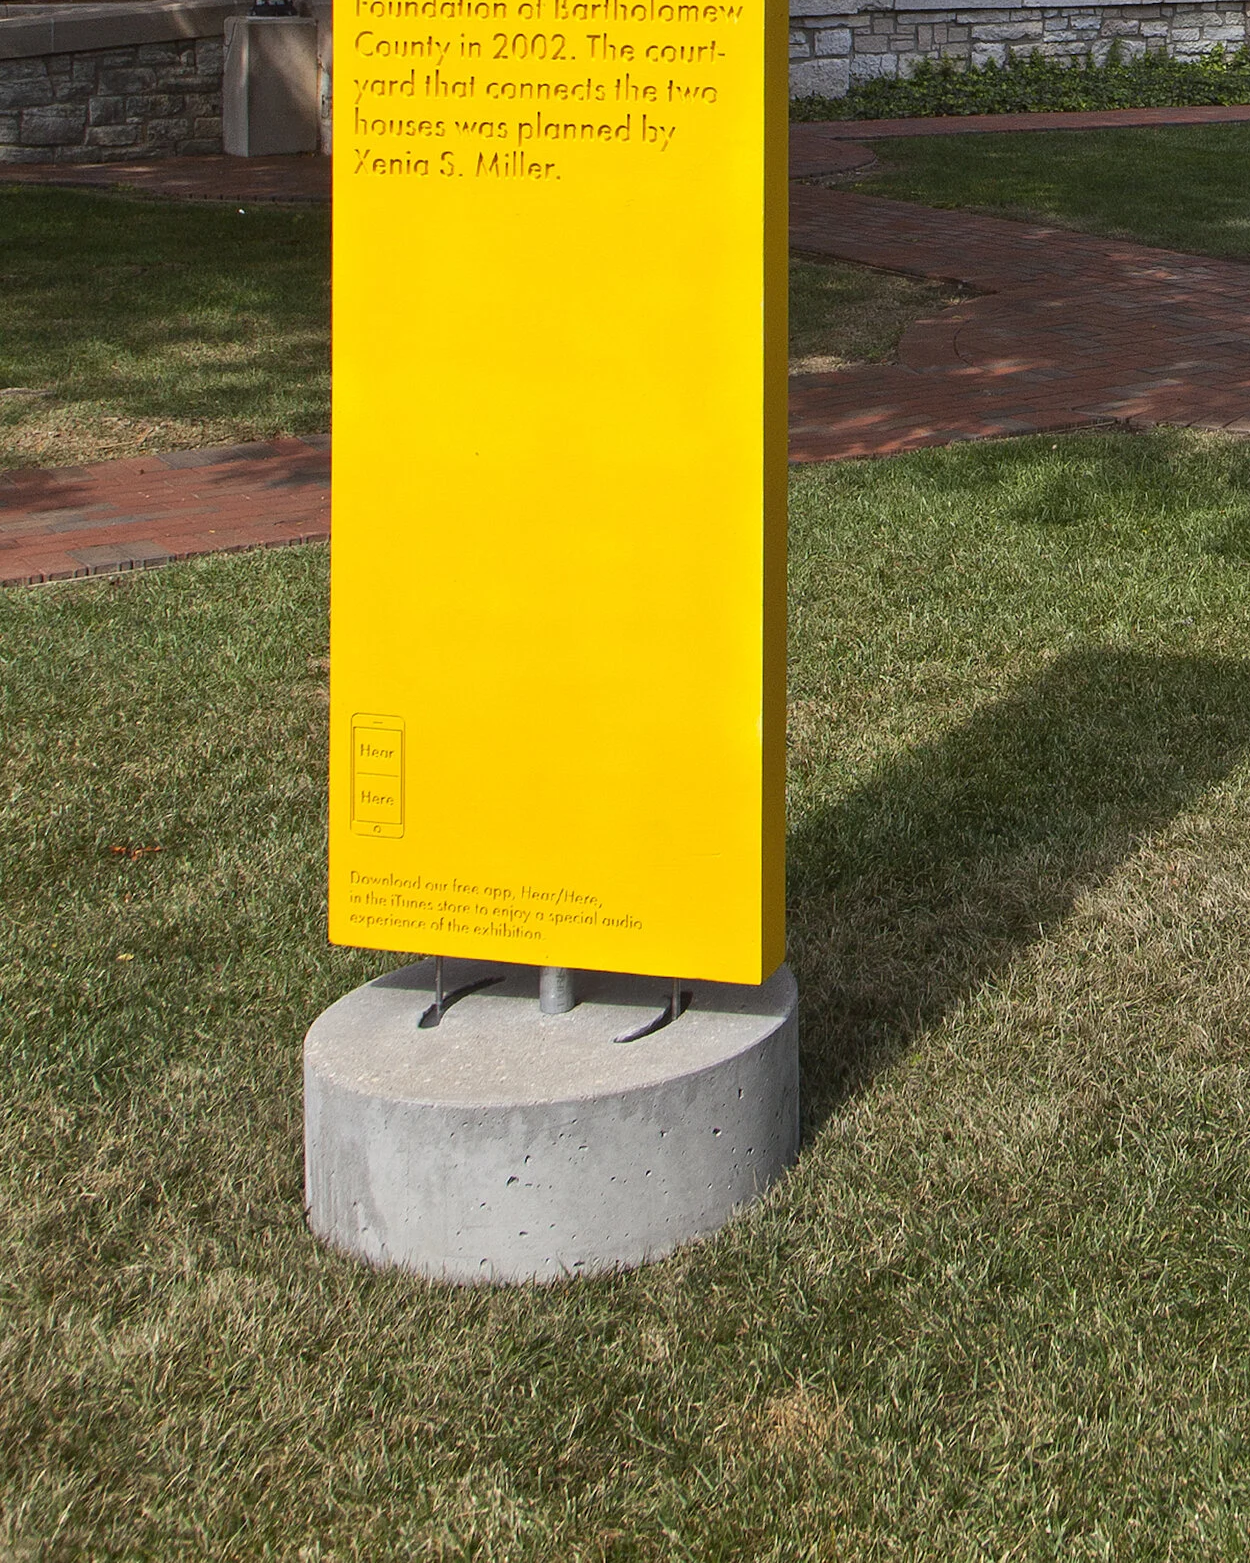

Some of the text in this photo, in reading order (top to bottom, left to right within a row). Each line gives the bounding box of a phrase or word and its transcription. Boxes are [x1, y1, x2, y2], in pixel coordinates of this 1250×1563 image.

[354, 31, 451, 65] County
[460, 31, 482, 59] in
[492, 33, 577, 61] 2002.
[586, 34, 635, 62] The
[353, 70, 719, 105] yard that connects the two
[354, 107, 676, 151] houses was planned by
[353, 148, 562, 181] Xenia S. Miller.
[359, 743, 395, 760] Hear
[360, 790, 395, 807] Here
[350, 870, 421, 890] Download
[425, 881, 448, 892] our
[453, 878, 479, 895] free
[483, 886, 515, 901] app,
[349, 890, 643, 930] in the iTunes store to enjoy a special audio
[349, 913, 426, 929] experience
[430, 917, 445, 931] of
[448, 918, 470, 934] the
